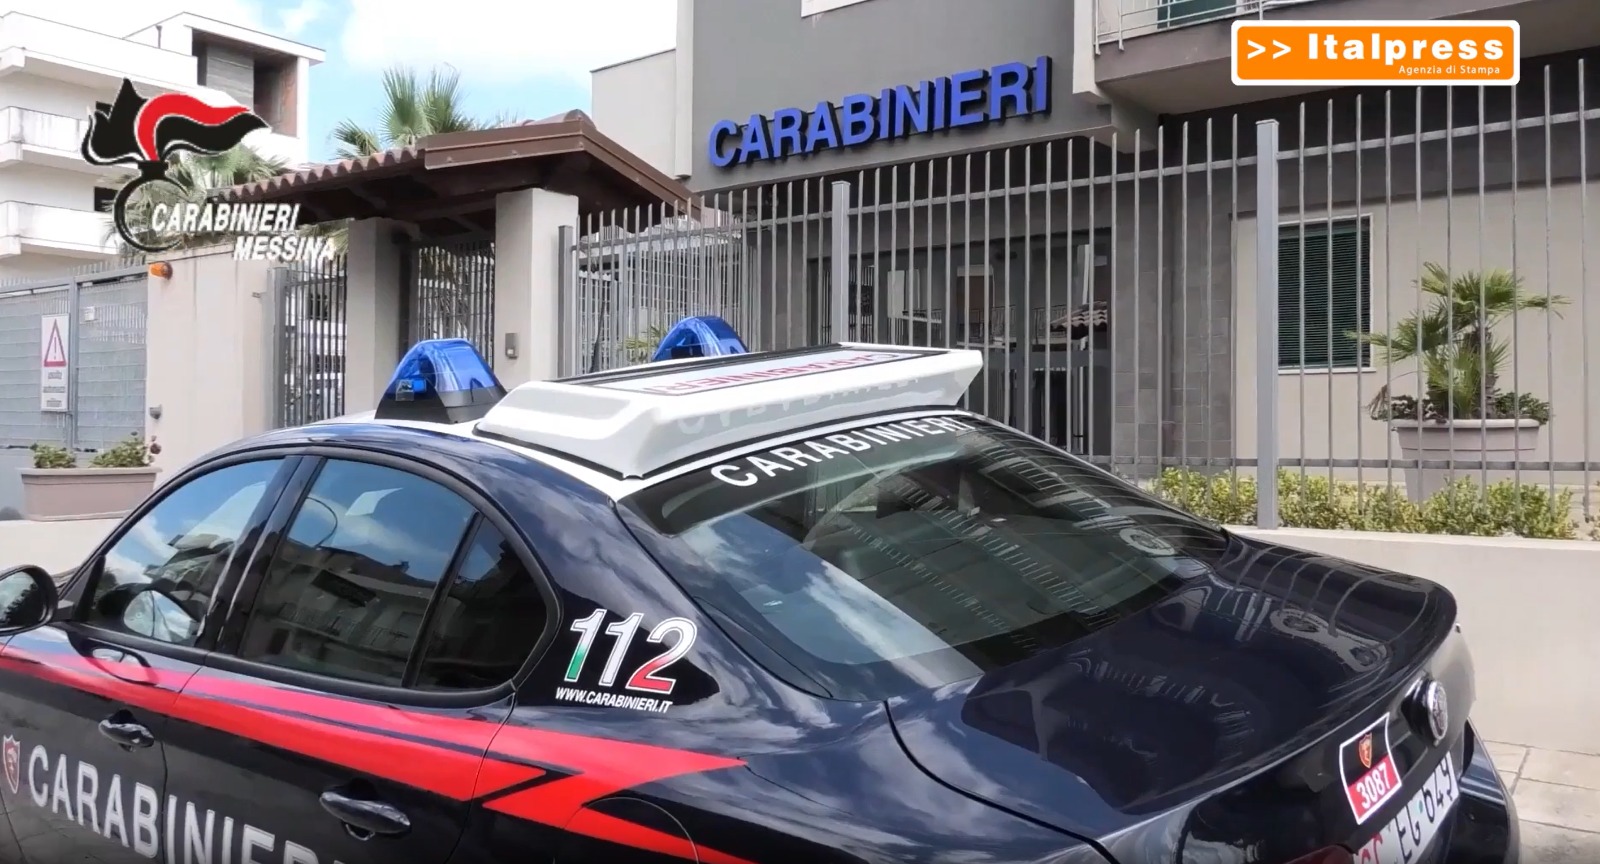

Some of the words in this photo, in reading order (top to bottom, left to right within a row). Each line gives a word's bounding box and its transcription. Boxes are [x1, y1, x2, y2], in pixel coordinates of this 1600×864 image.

[708, 56, 1053, 168] CARABINIERI
[711, 415, 975, 487] CARABINIERI
[564, 608, 698, 695] 112
[555, 687, 673, 714] WWW.CARABINIERI.IT
[28, 744, 346, 864] CARABINIE
[1356, 762, 1391, 809] 3087
